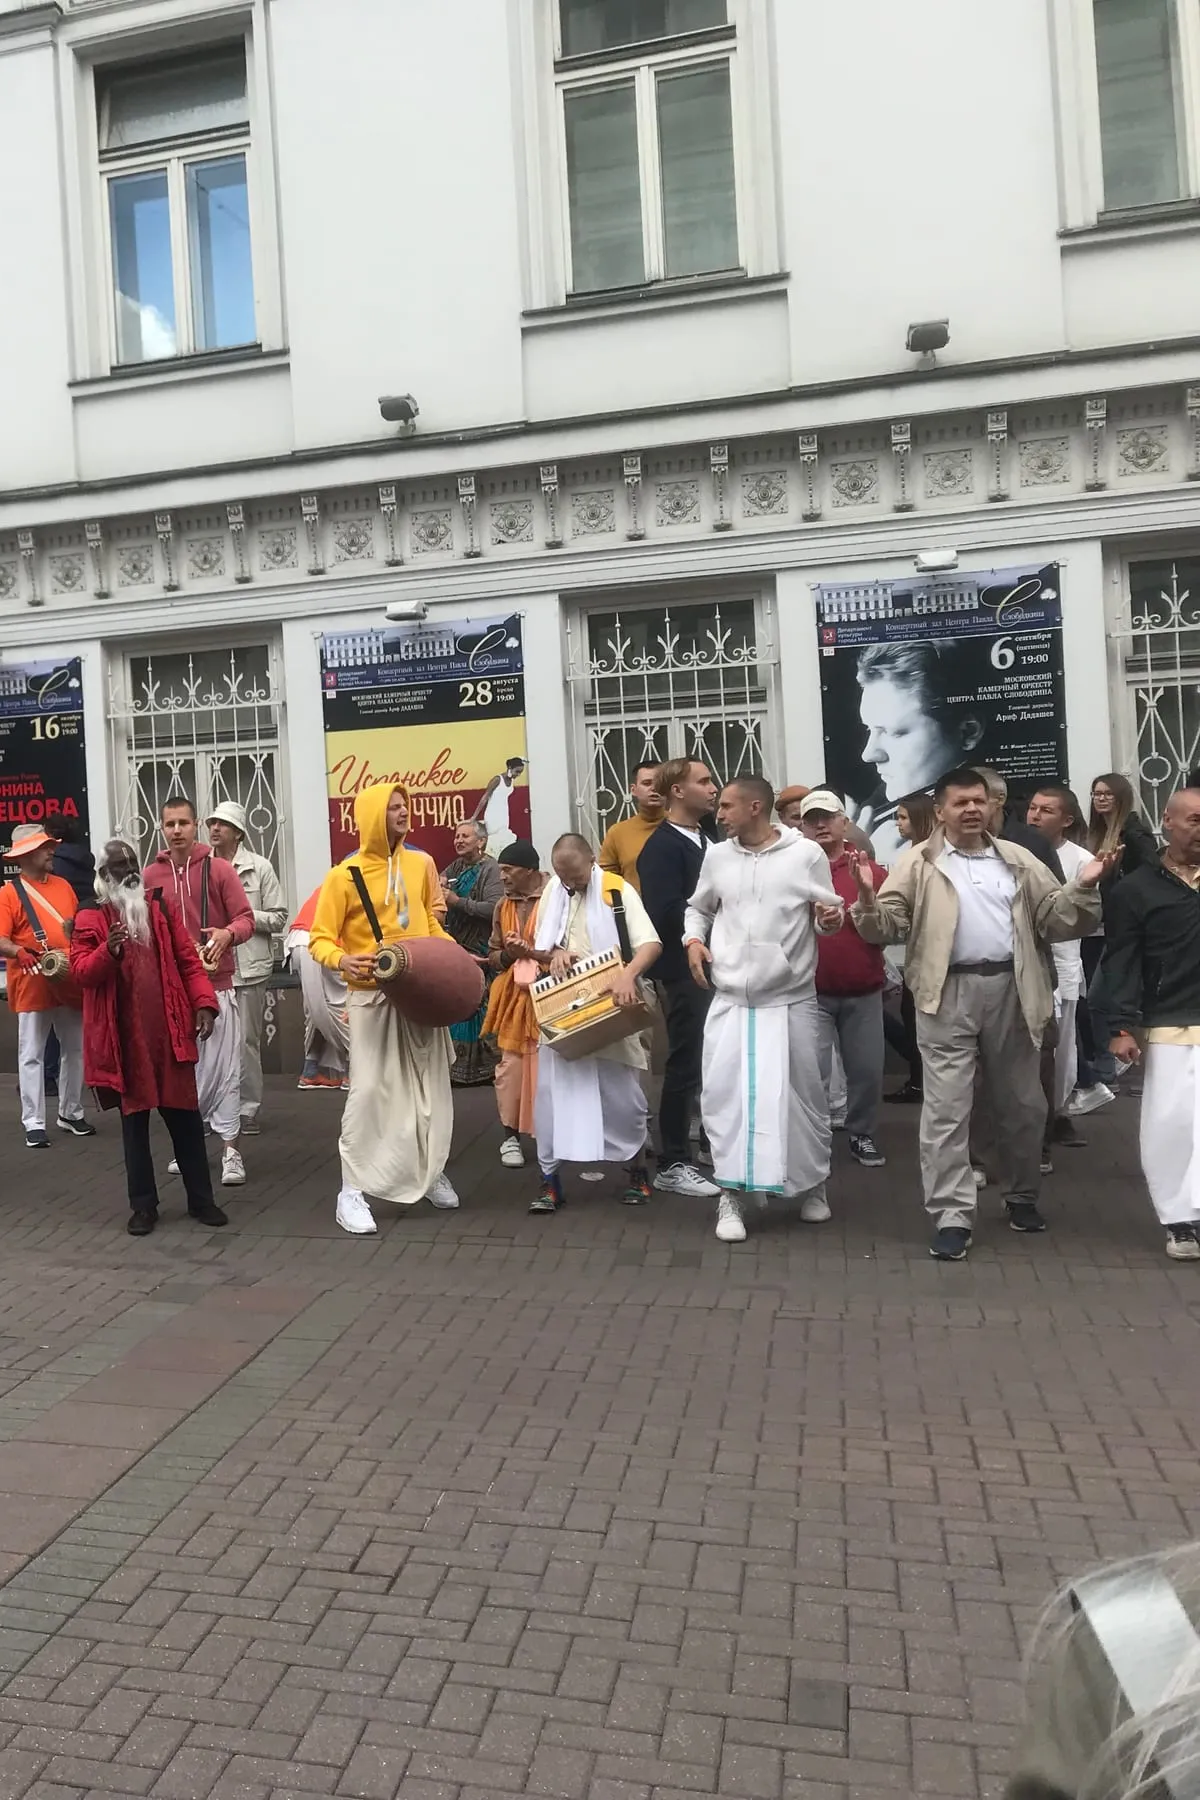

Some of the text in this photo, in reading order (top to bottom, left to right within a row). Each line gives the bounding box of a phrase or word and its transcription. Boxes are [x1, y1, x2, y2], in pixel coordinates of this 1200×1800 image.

[885, 622, 927, 633] Концертный
[945, 618, 969, 627] Центра
[972, 615, 993, 623] Павла
[1014, 633, 1052, 642] сентября
[990, 636, 1016, 670] 6
[1016, 642, 1051, 652] (пятница)
[1020, 653, 1049, 665] 19:00
[492, 677, 519, 686] августа
[1004, 672, 1052, 684] МОСКОВСКИЙ
[978, 681, 1053, 694] КАМЕРНЫЙ ОРКЕСТР
[351, 692, 383, 701] МОСКОВСКИЙ
[459, 680, 493, 708] 28
[495, 694, 515, 702] 19:00
[946, 688, 1053, 704] ЦЕНТРА ПАВЛА СЛОБОДКИНА
[995, 710, 1054, 723] Ариф Дадашев
[30, 715, 60, 740] 16
[62, 728, 78, 736] 19:00
[331, 747, 468, 795] Испанское
